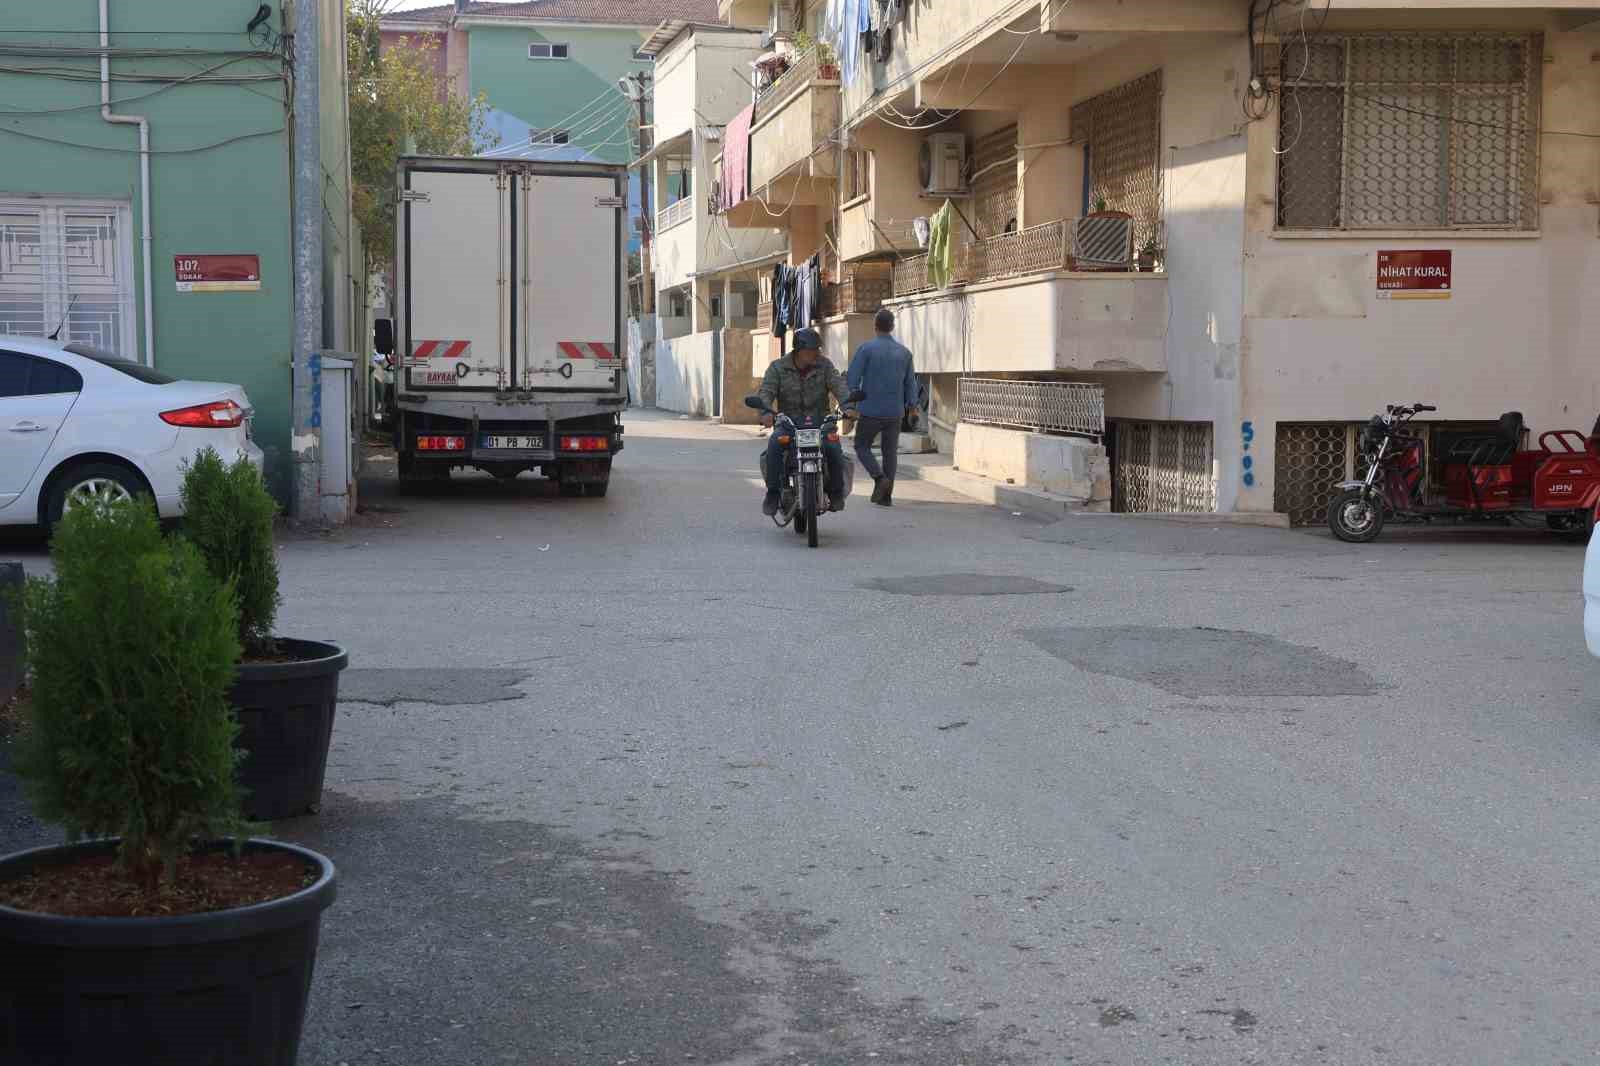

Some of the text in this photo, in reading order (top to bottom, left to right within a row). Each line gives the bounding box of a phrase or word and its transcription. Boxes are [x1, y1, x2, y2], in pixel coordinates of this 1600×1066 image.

[1414, 266, 1448, 277] KURAL
[488, 437, 499, 448] 01
[526, 437, 544, 448] 702
[1548, 484, 1573, 492] JPN
